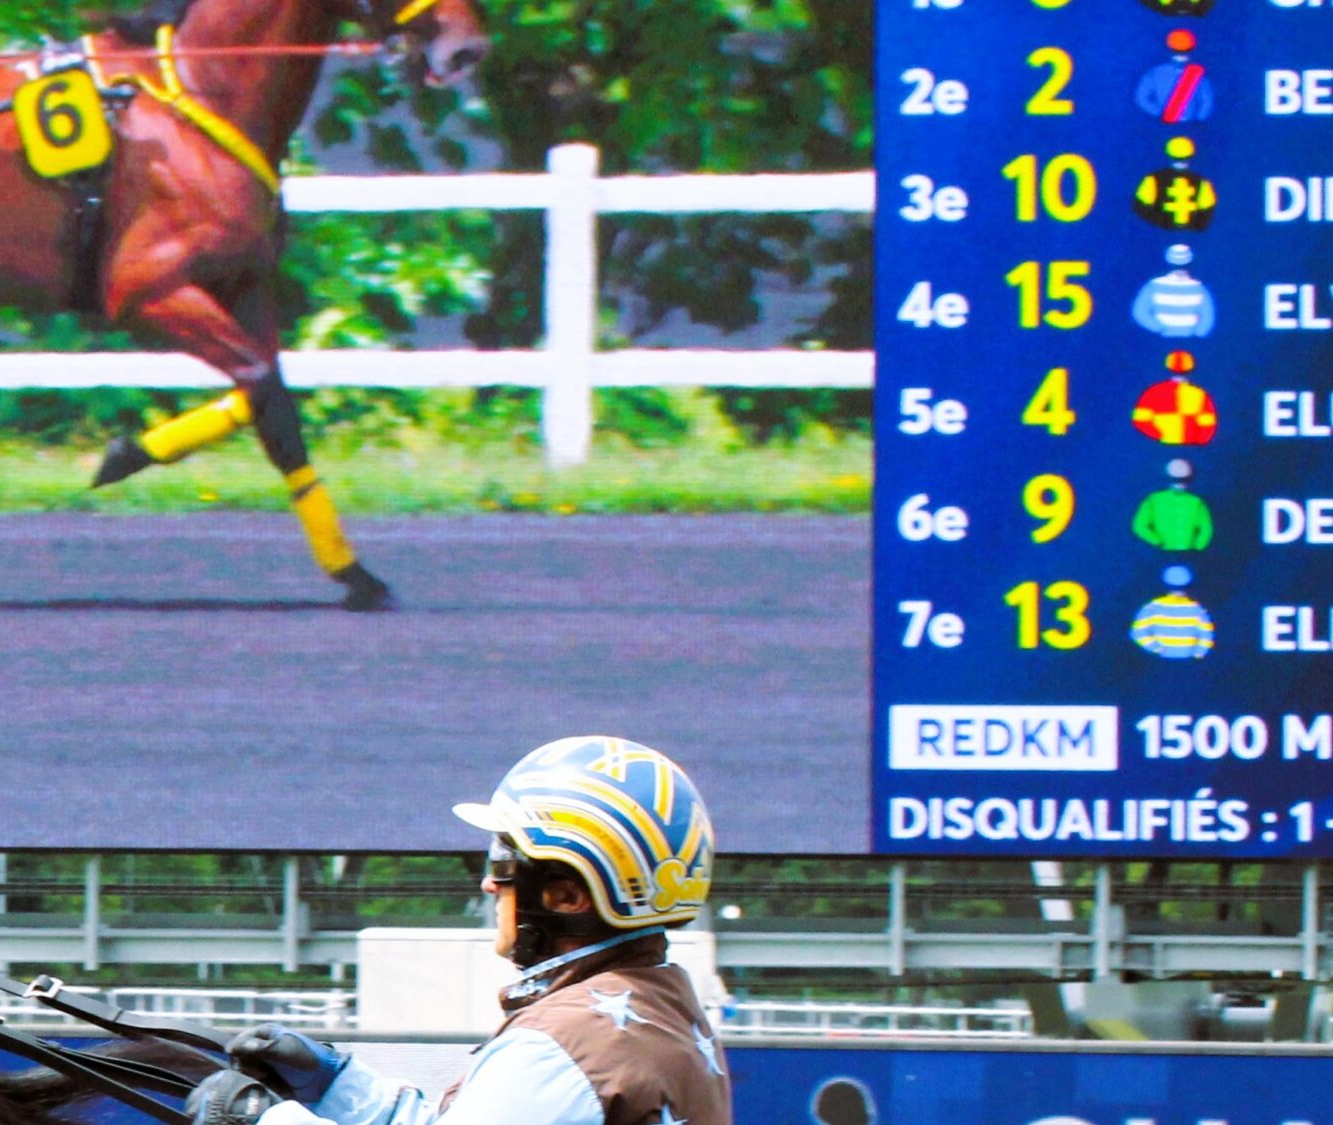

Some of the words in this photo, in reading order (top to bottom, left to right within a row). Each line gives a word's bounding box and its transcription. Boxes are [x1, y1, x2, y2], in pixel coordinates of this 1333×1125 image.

[35, 78, 87, 148] 6
[902, 68, 968, 115] 2e
[1028, 46, 1073, 115] 2
[901, 174, 969, 221] 3e
[1003, 153, 1096, 222] 10
[1266, 176, 1333, 221] DI
[899, 281, 969, 328] 4e
[1007, 260, 1092, 329] 15
[1266, 284, 1333, 329] EL
[900, 388, 967, 434] 5e
[1024, 367, 1075, 435] 4
[1266, 391, 1333, 436] EL
[899, 493, 969, 541] 6e
[1024, 473, 1074, 543] 9
[900, 600, 965, 648] 7e
[1006, 581, 1090, 649] 13
[1264, 606, 1333, 651] EL
[916, 718, 1096, 757] REDKM
[1138, 715, 1268, 759] 1500
[891, 788, 1250, 842] DISQUALIFIÉS
